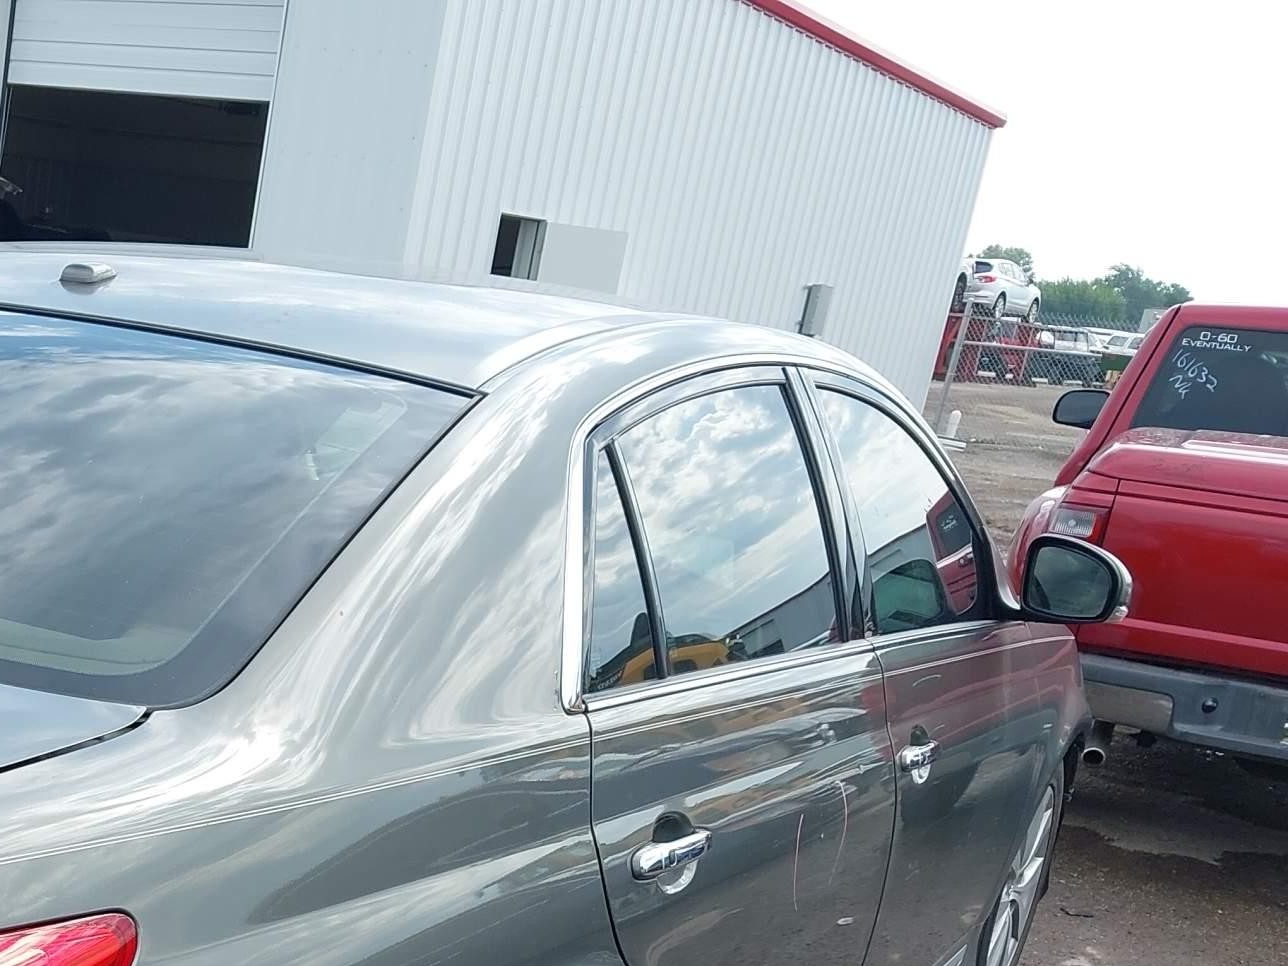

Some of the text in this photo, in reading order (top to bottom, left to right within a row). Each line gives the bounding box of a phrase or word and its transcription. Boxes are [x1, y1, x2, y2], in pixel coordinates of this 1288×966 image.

[1200, 331, 1238, 343] 0-60
[1182, 338, 1252, 352] EVENTUALLY
[1172, 349, 1217, 392] 161632
